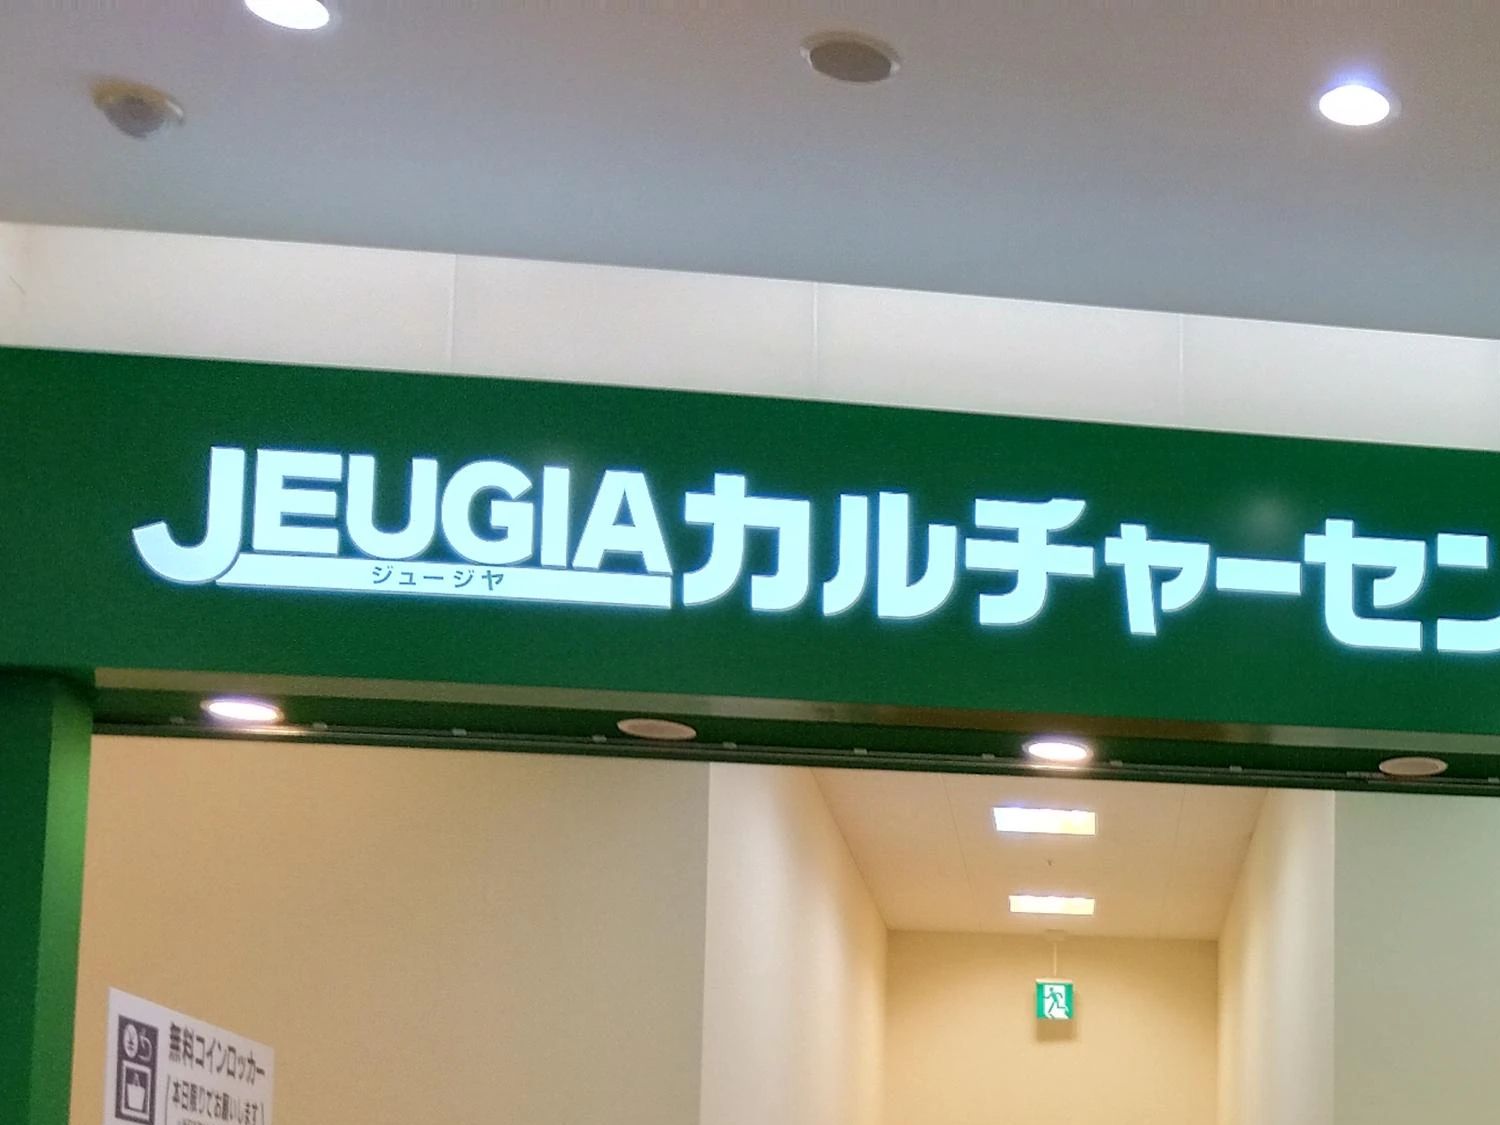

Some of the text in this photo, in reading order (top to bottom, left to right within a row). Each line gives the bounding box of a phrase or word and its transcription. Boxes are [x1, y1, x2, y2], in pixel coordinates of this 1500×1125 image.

[132, 446, 671, 584] JEUGIA
[168, 1020, 266, 1086] 無料コインロッカー
